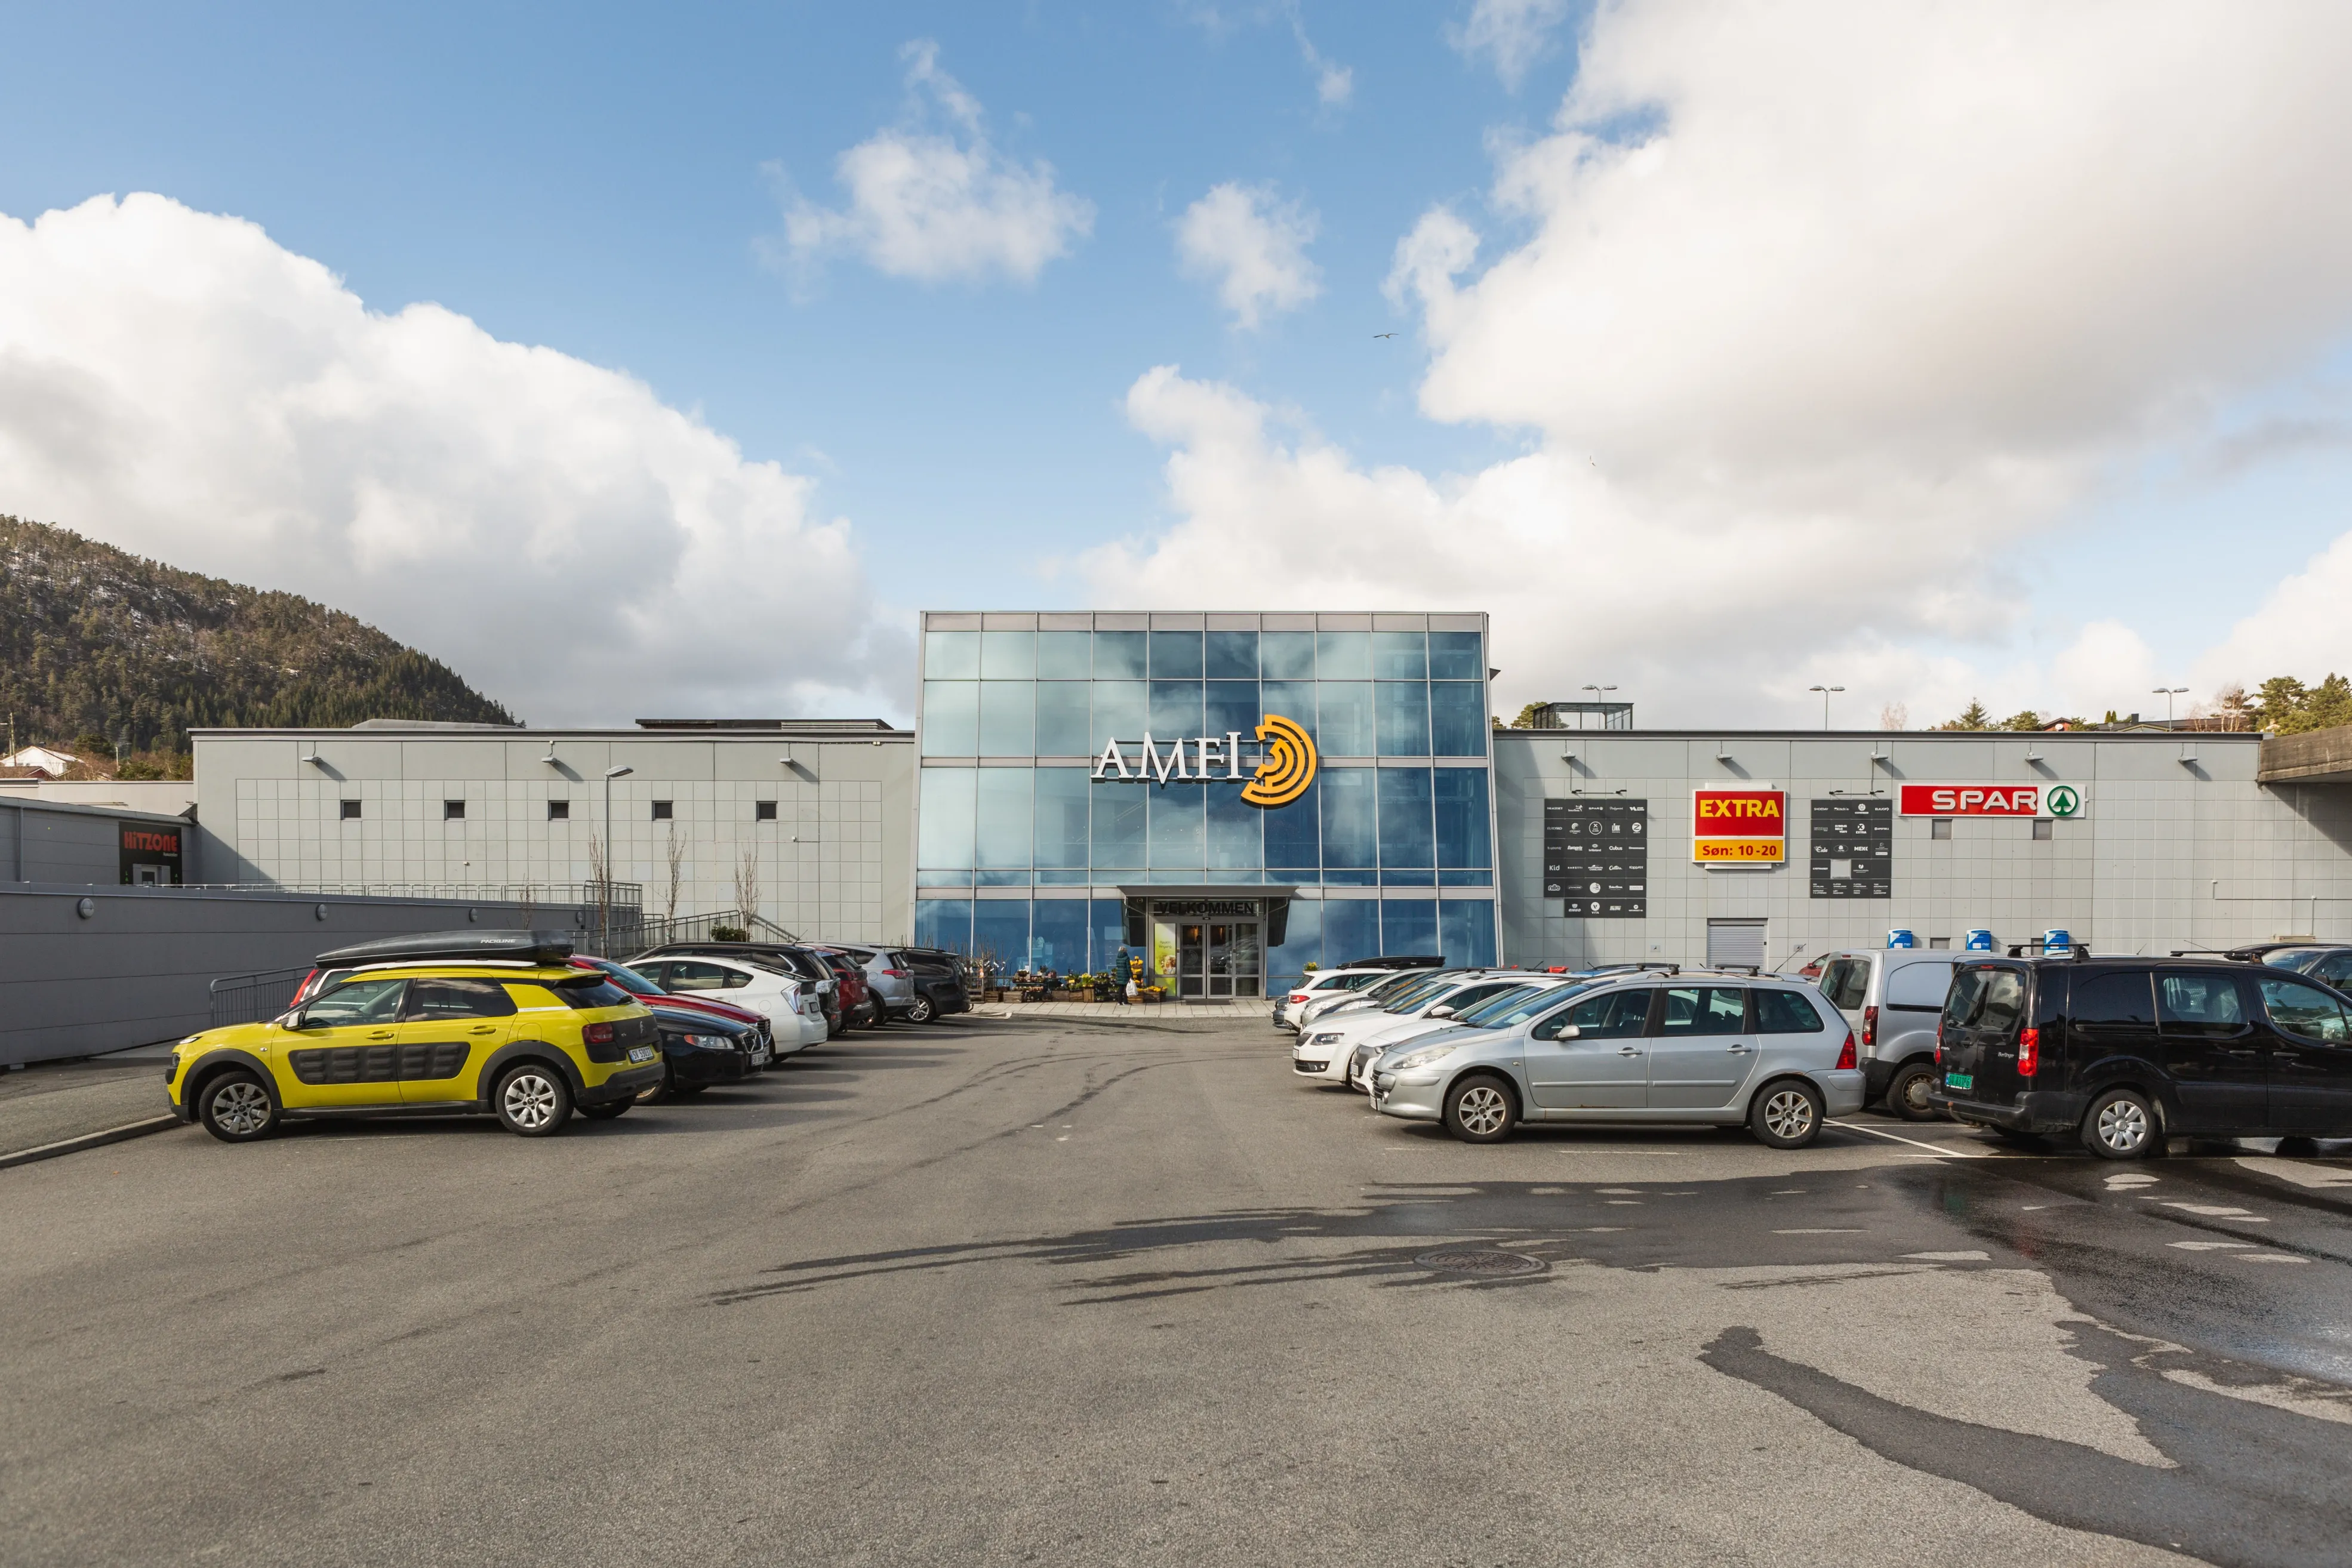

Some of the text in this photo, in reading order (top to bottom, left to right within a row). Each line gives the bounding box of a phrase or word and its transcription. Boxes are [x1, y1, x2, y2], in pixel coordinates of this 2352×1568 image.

[1091, 732, 1243, 784] AMFI
[1932, 790, 2037, 811] SPAR
[1700, 799, 1780, 818] EXTRA
[1703, 845, 1734, 856] Søn:
[1159, 902, 1253, 914] VELKOMMEN
[632, 1049, 639, 1059] SV
